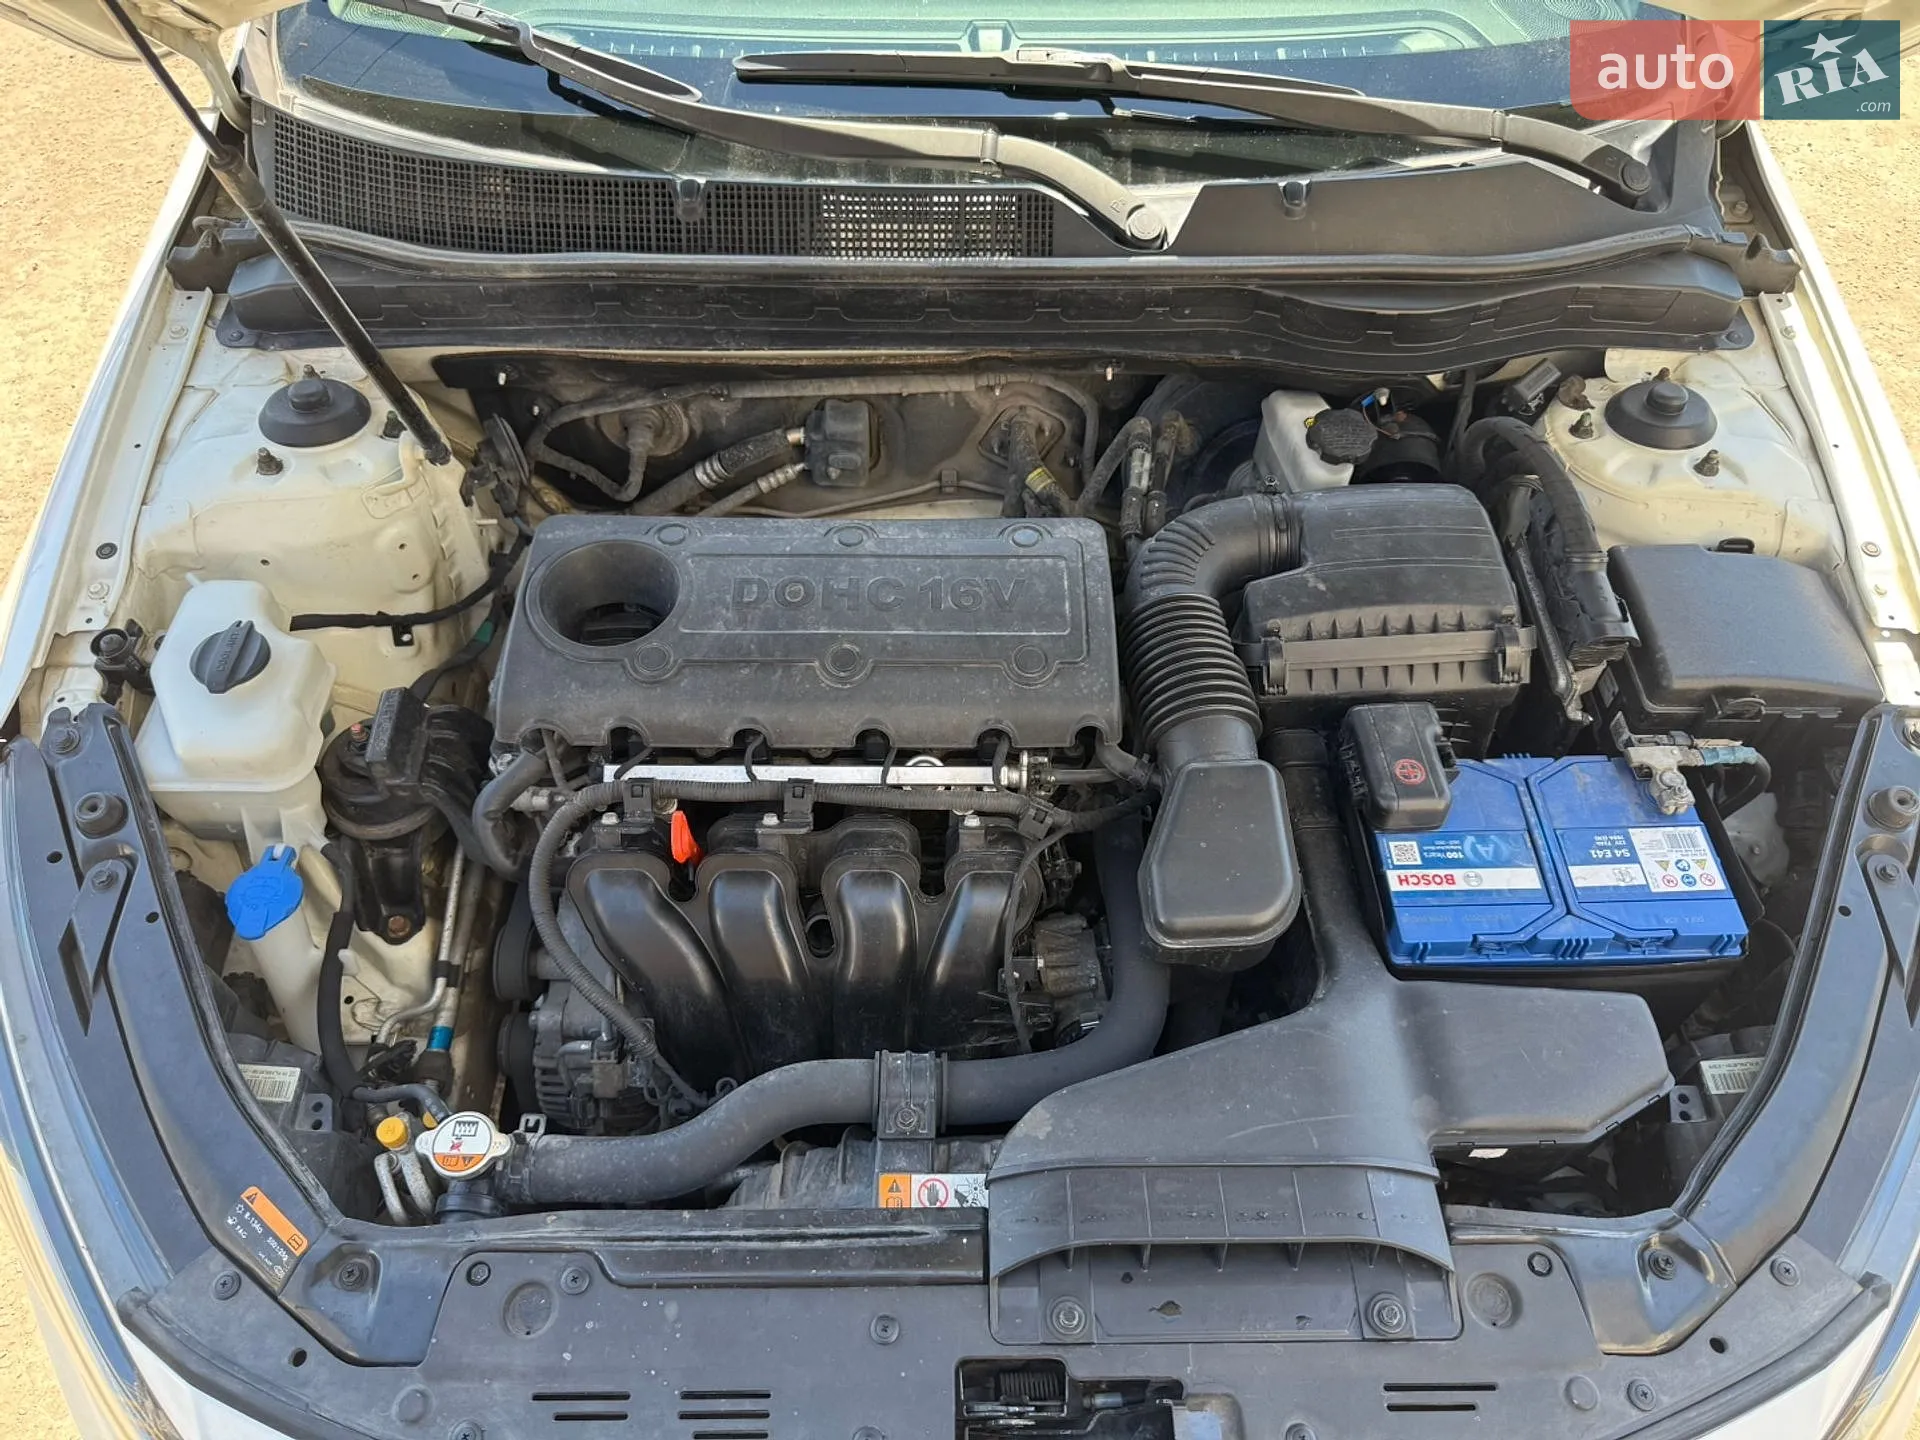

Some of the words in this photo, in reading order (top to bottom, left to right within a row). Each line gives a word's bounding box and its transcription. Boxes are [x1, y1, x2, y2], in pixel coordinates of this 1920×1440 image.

[731, 575, 905, 612] DOHC
[918, 575, 1026, 612] 16V
[1589, 849, 1610, 859] E41
[1613, 849, 1631, 858] S4
[1397, 873, 1457, 887] BOSCH
